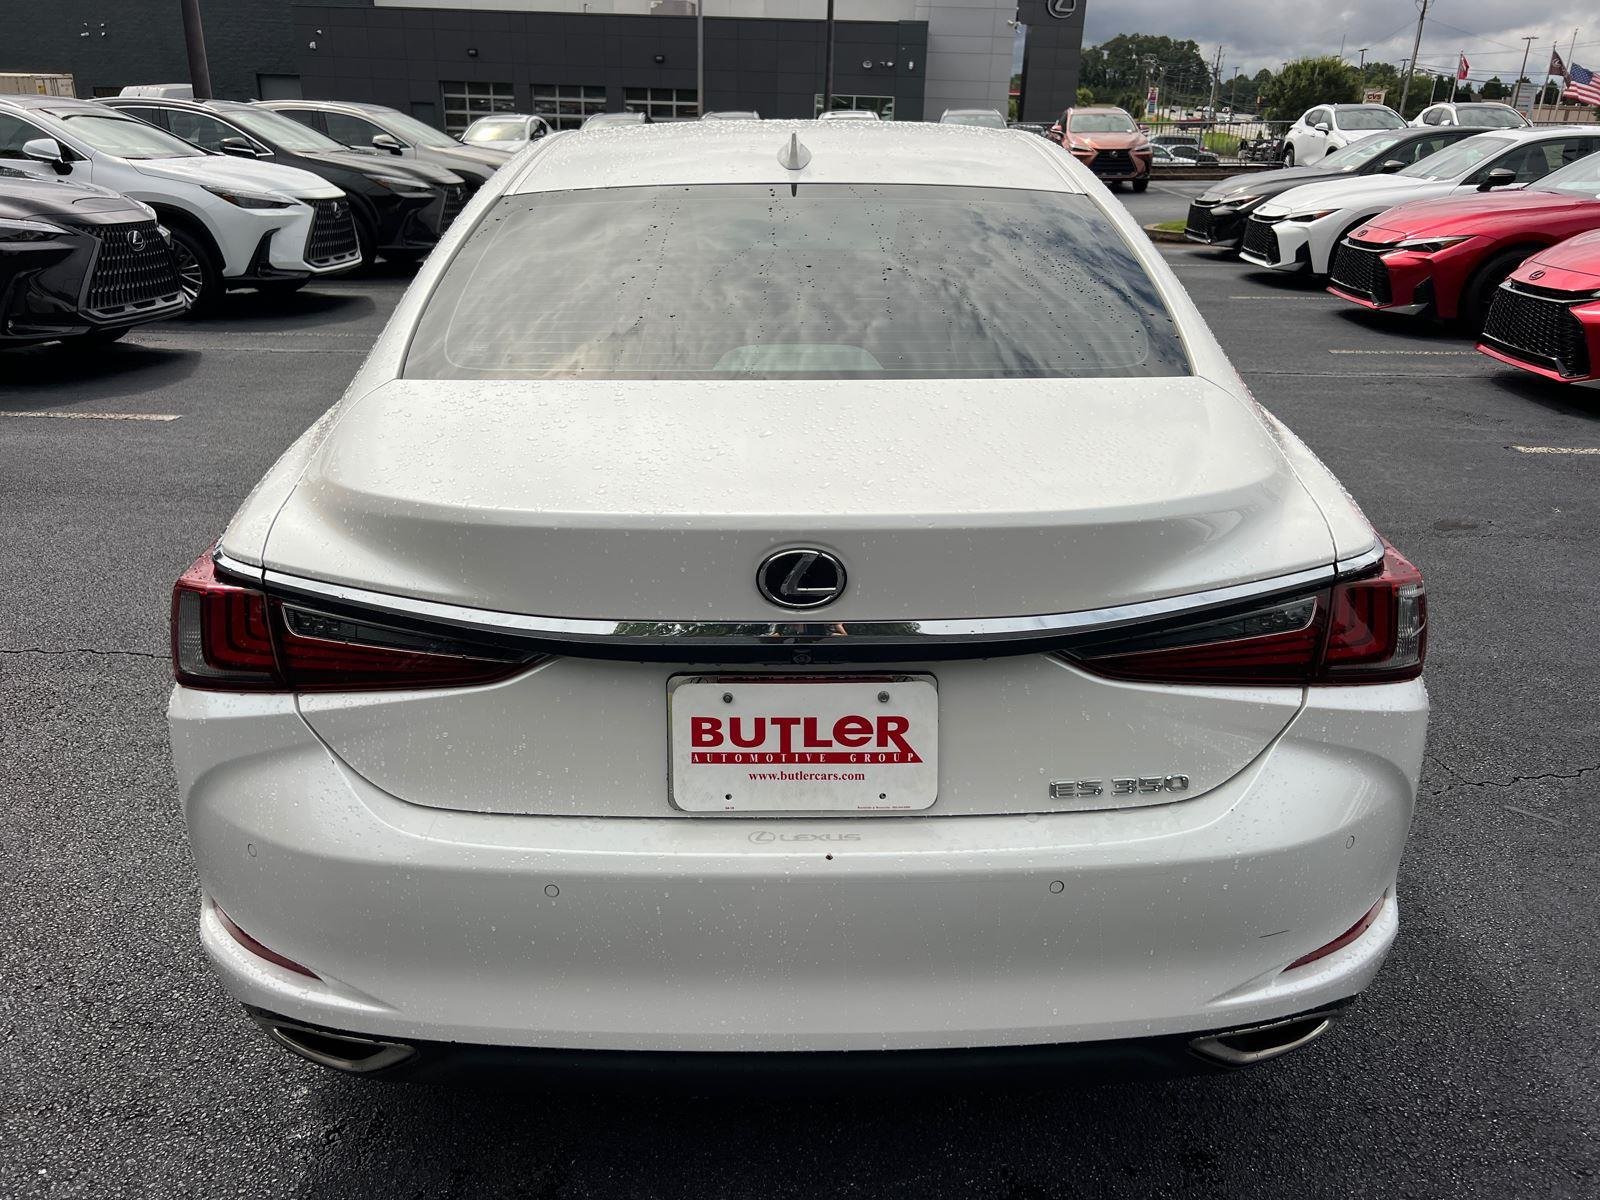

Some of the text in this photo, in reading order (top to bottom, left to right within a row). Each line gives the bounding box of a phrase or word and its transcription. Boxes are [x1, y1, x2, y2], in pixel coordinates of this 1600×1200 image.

[693, 753, 914, 763] AUTOMOTIVE GROUP
[748, 771, 865, 781] www.butlercars.com
[1049, 774, 1189, 799] ES 350
[779, 833, 861, 842] LEXUS
